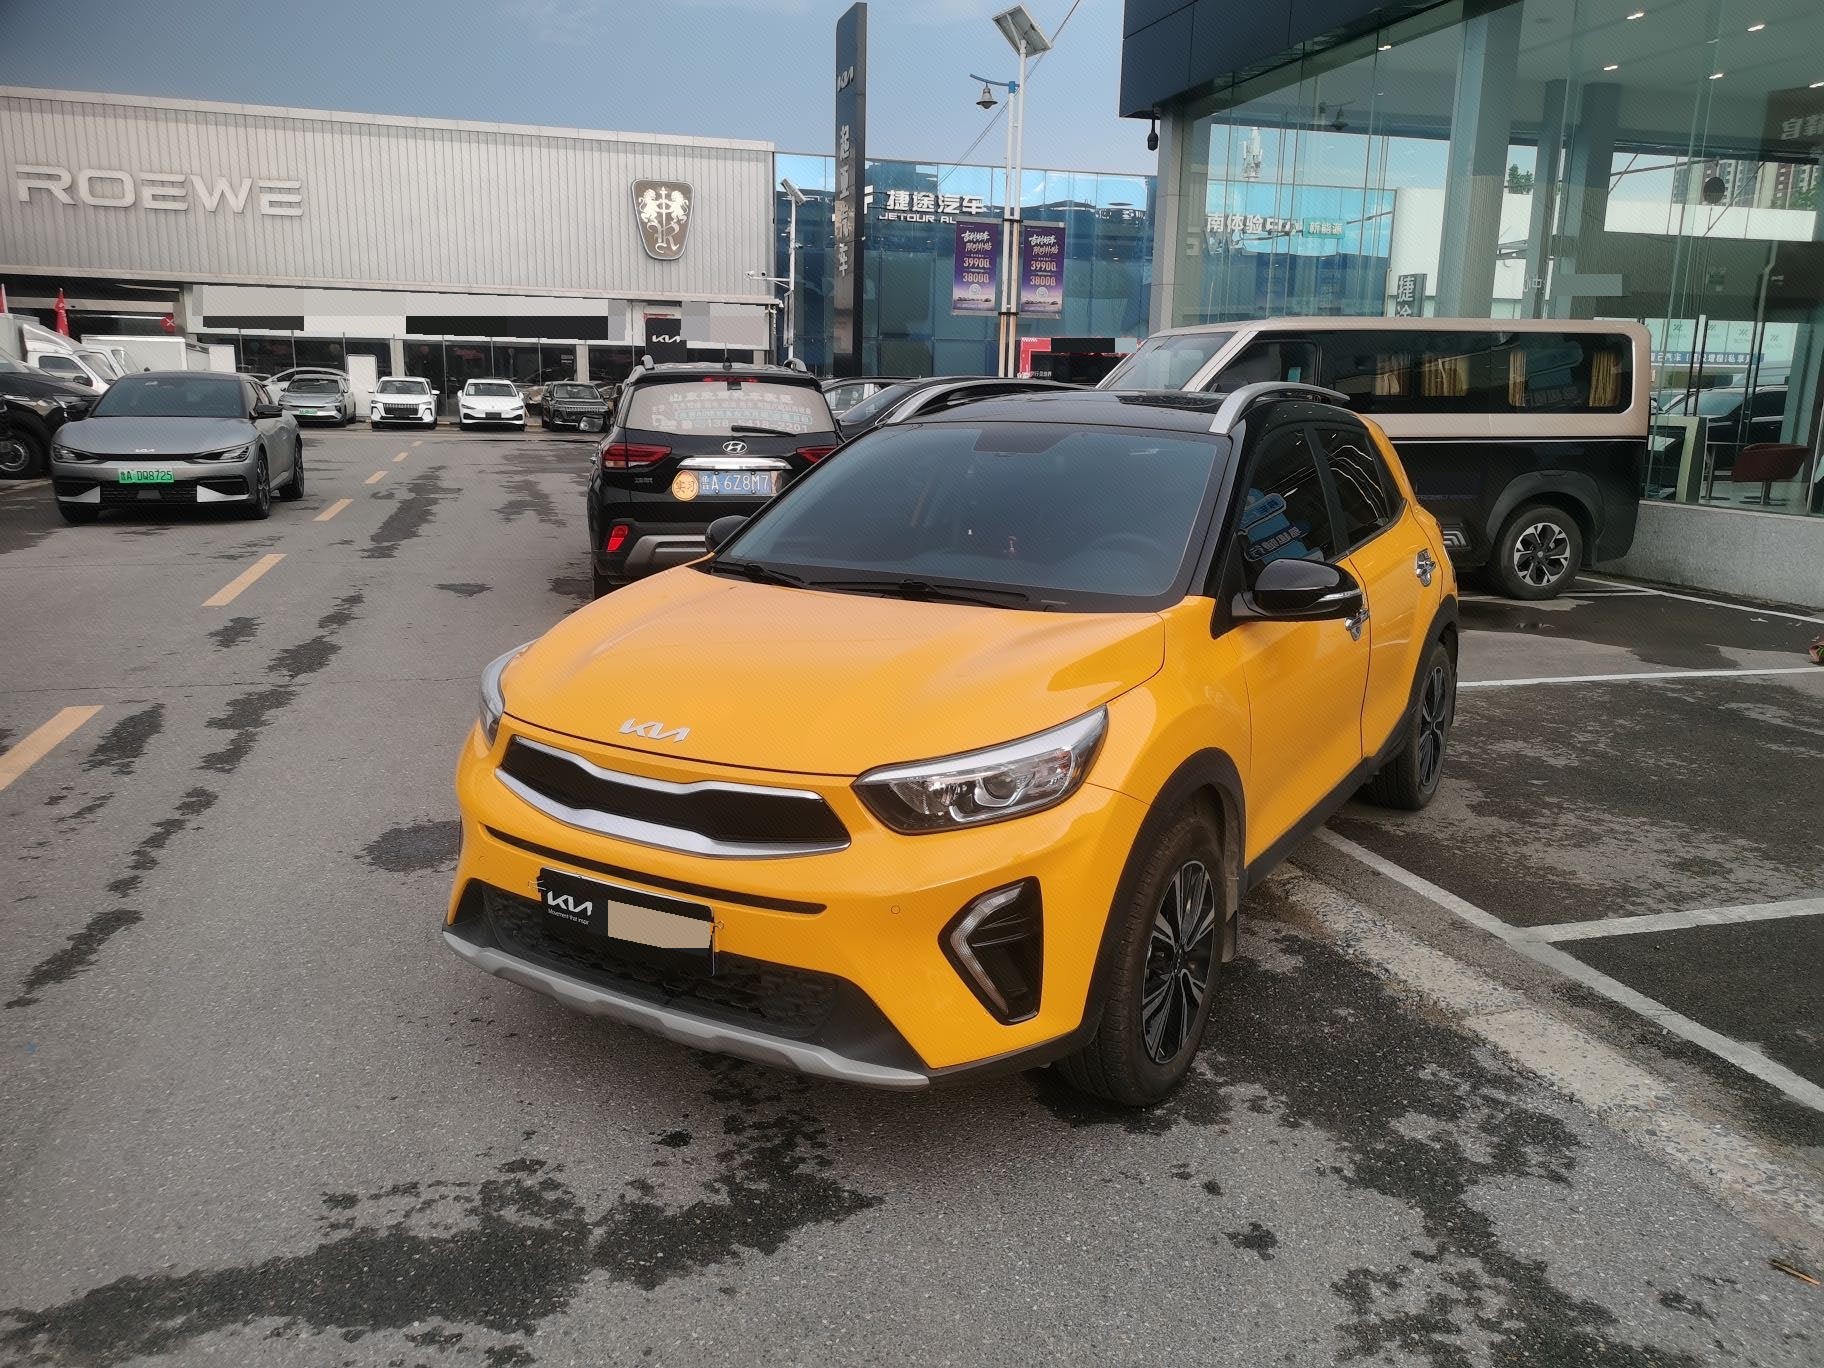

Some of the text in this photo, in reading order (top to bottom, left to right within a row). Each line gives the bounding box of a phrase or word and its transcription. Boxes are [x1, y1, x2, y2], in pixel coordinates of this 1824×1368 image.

[15, 164, 304, 216] ROEWE
[886, 189, 985, 215] 捷途汽车
[878, 212, 936, 223] JETOUR
[1309, 222, 1343, 235] 新能源
[136, 470, 173, 481] DQ8725
